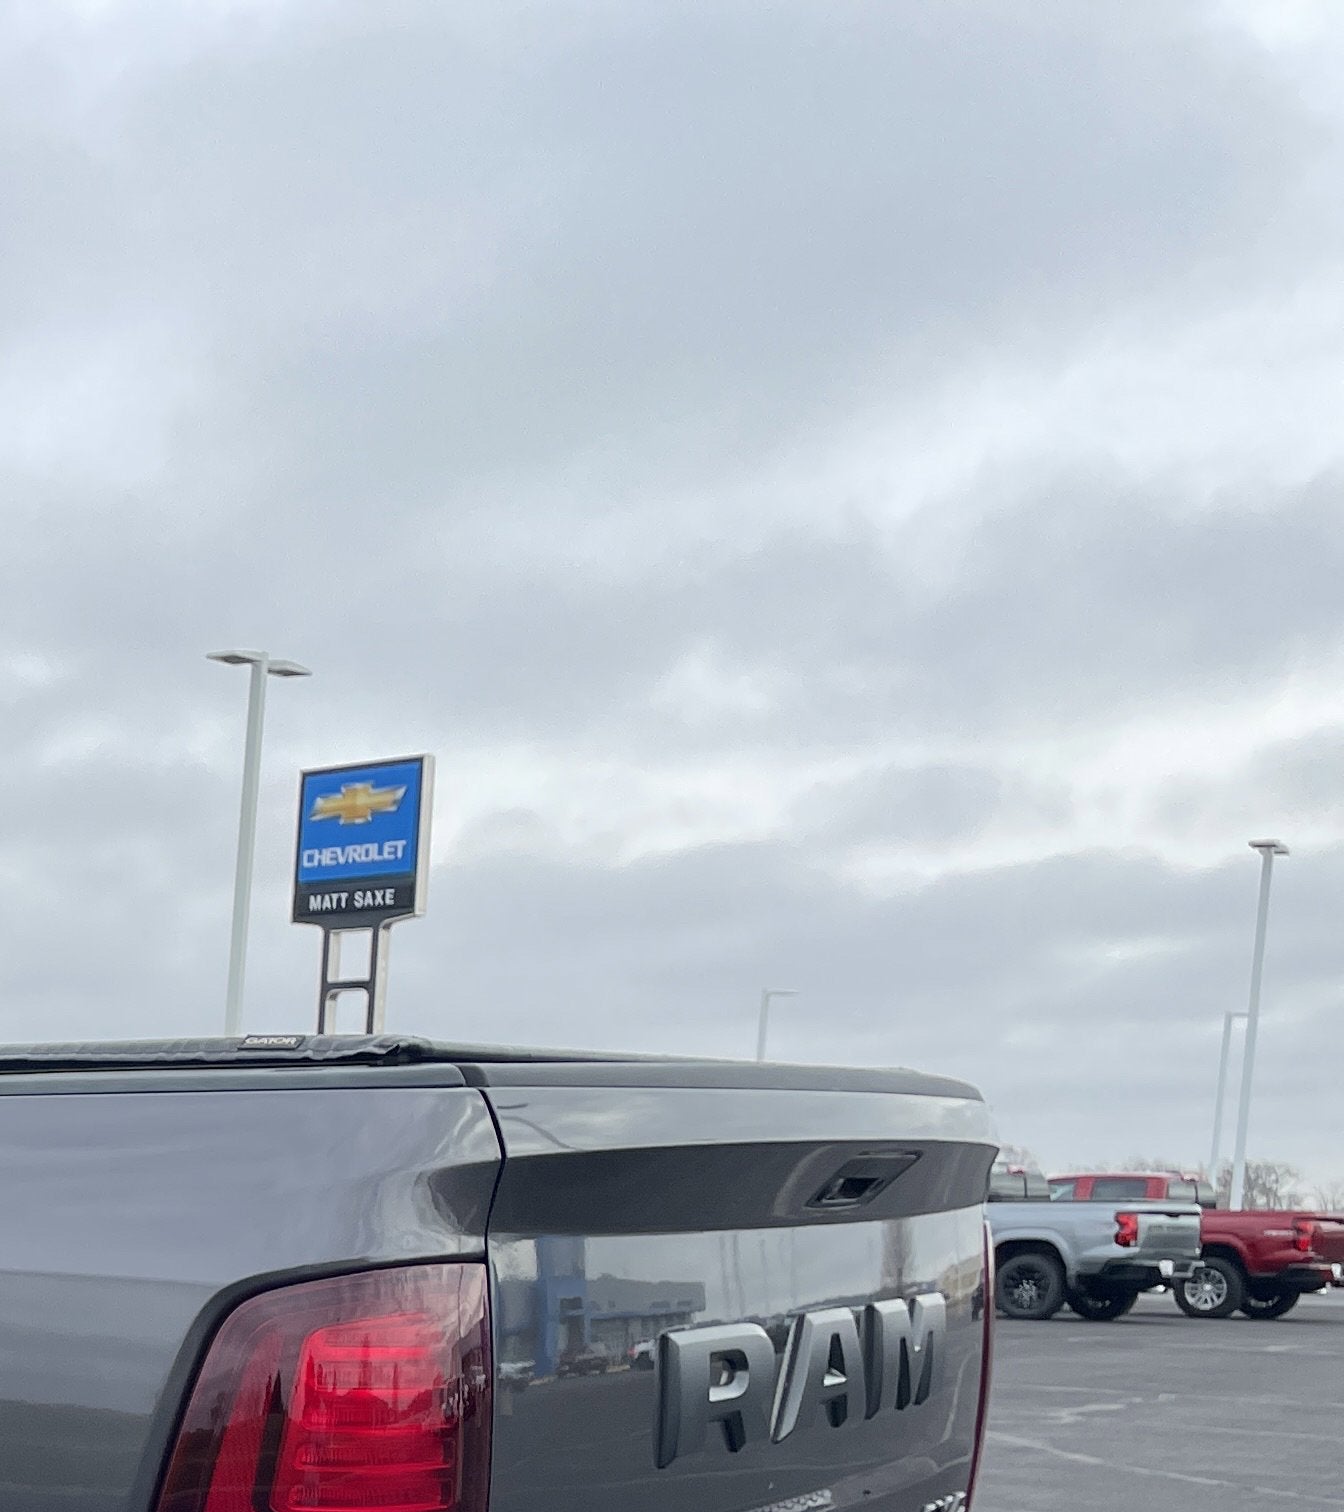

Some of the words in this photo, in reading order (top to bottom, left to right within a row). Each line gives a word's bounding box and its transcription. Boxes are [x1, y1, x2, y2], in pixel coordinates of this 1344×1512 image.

[302, 840, 406, 868] CHEVROLET
[309, 892, 348, 912] MATT
[354, 888, 395, 907] SAXE
[656, 1292, 946, 1469] RAM
